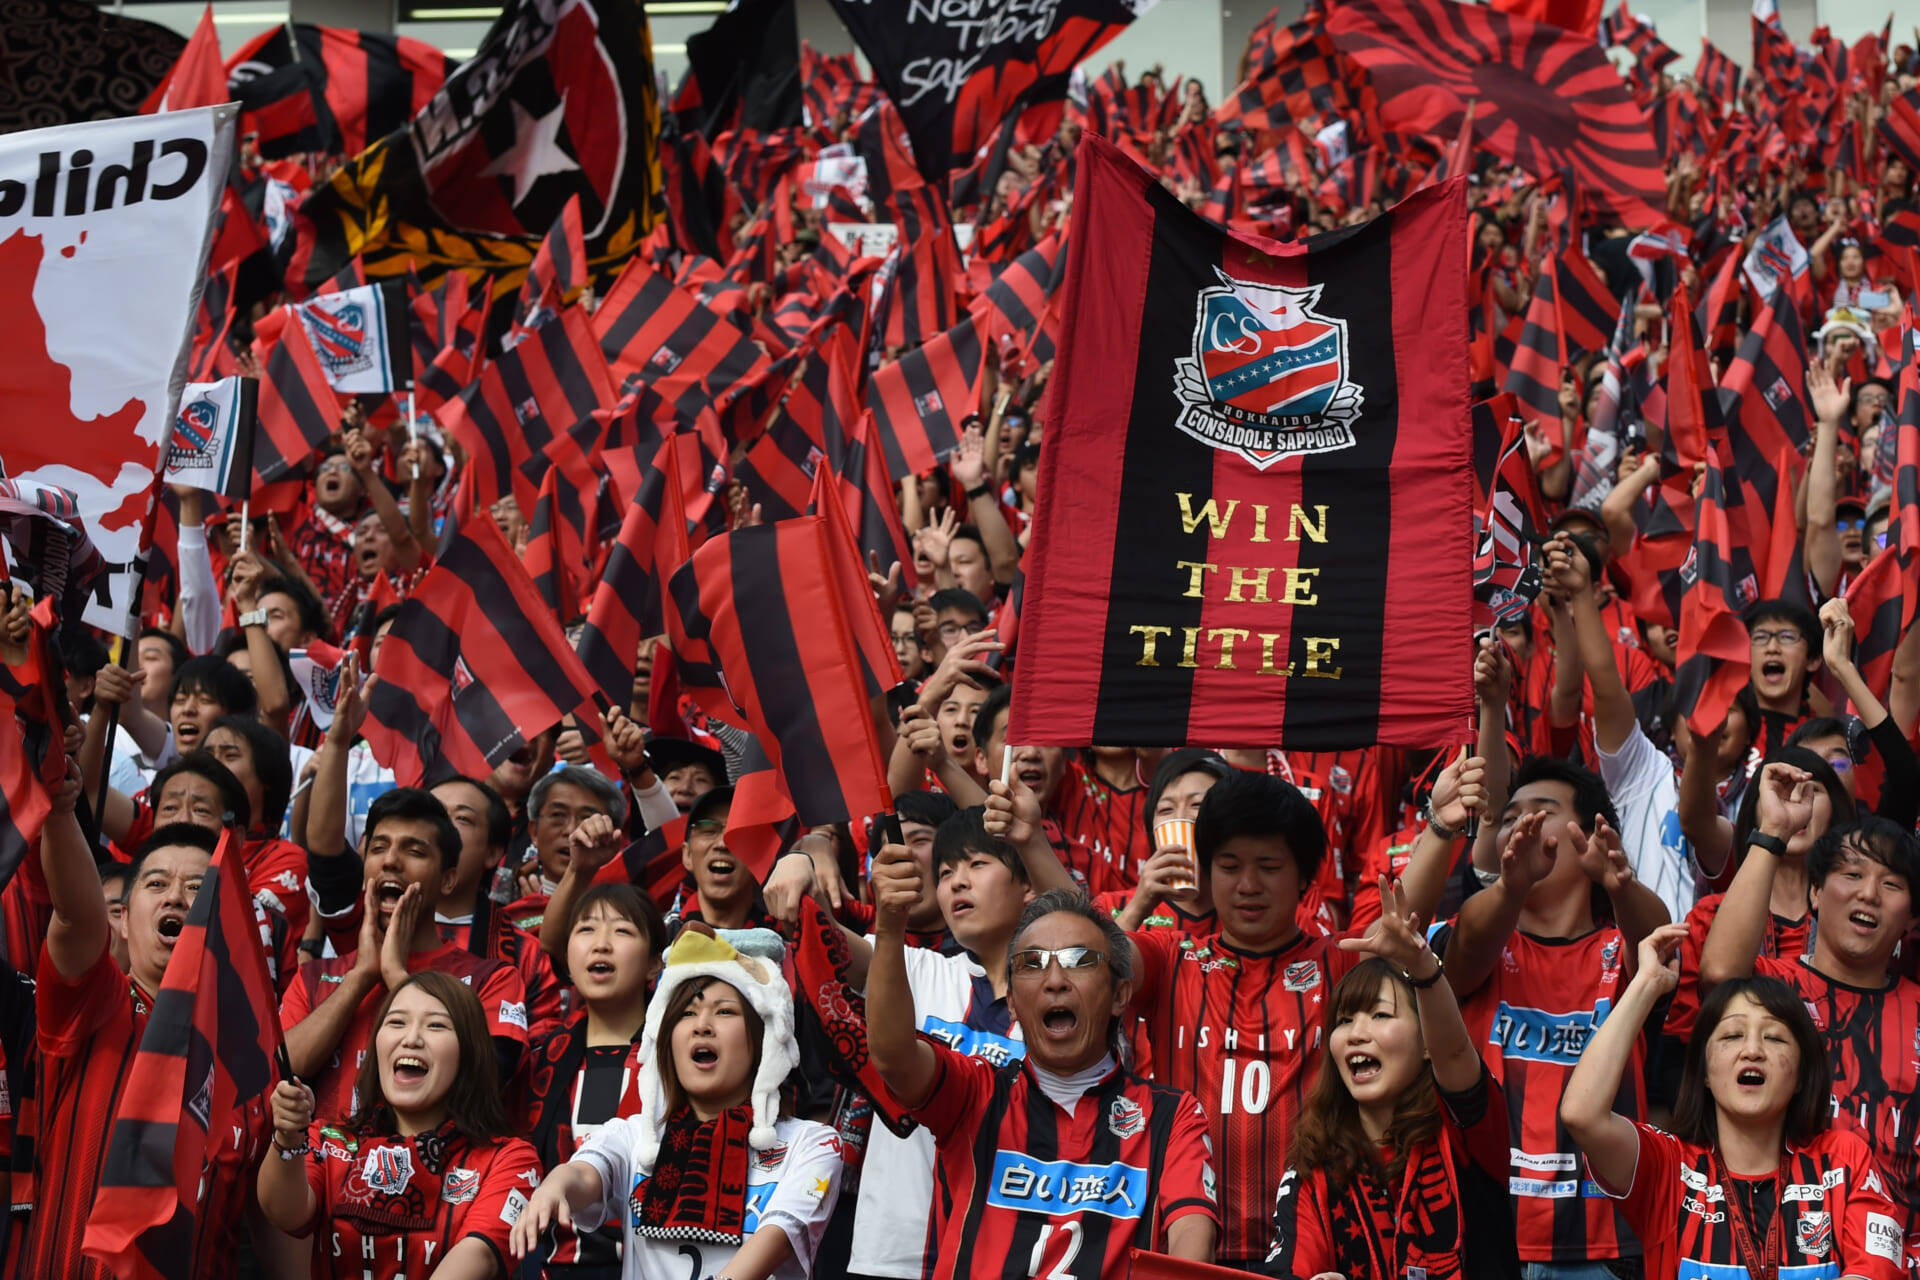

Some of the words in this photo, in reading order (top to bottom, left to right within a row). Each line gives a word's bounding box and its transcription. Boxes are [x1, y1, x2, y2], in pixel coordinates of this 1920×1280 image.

[1210, 312, 1262, 355] CS
[1187, 409, 1273, 450] CONSADOLE
[1277, 425, 1346, 450] SAPPORO
[1223, 405, 1312, 425] HOKKAIDO
[1175, 492, 1330, 543] WIN
[1176, 560, 1320, 606] THE
[1129, 625, 1343, 680] TITLE
[1178, 1025, 1323, 1051] ISHIYA
[1221, 1058, 1271, 1114] 10
[999, 1163, 1137, 1208] 白い恋人
[1028, 1221, 1083, 1280] 12
